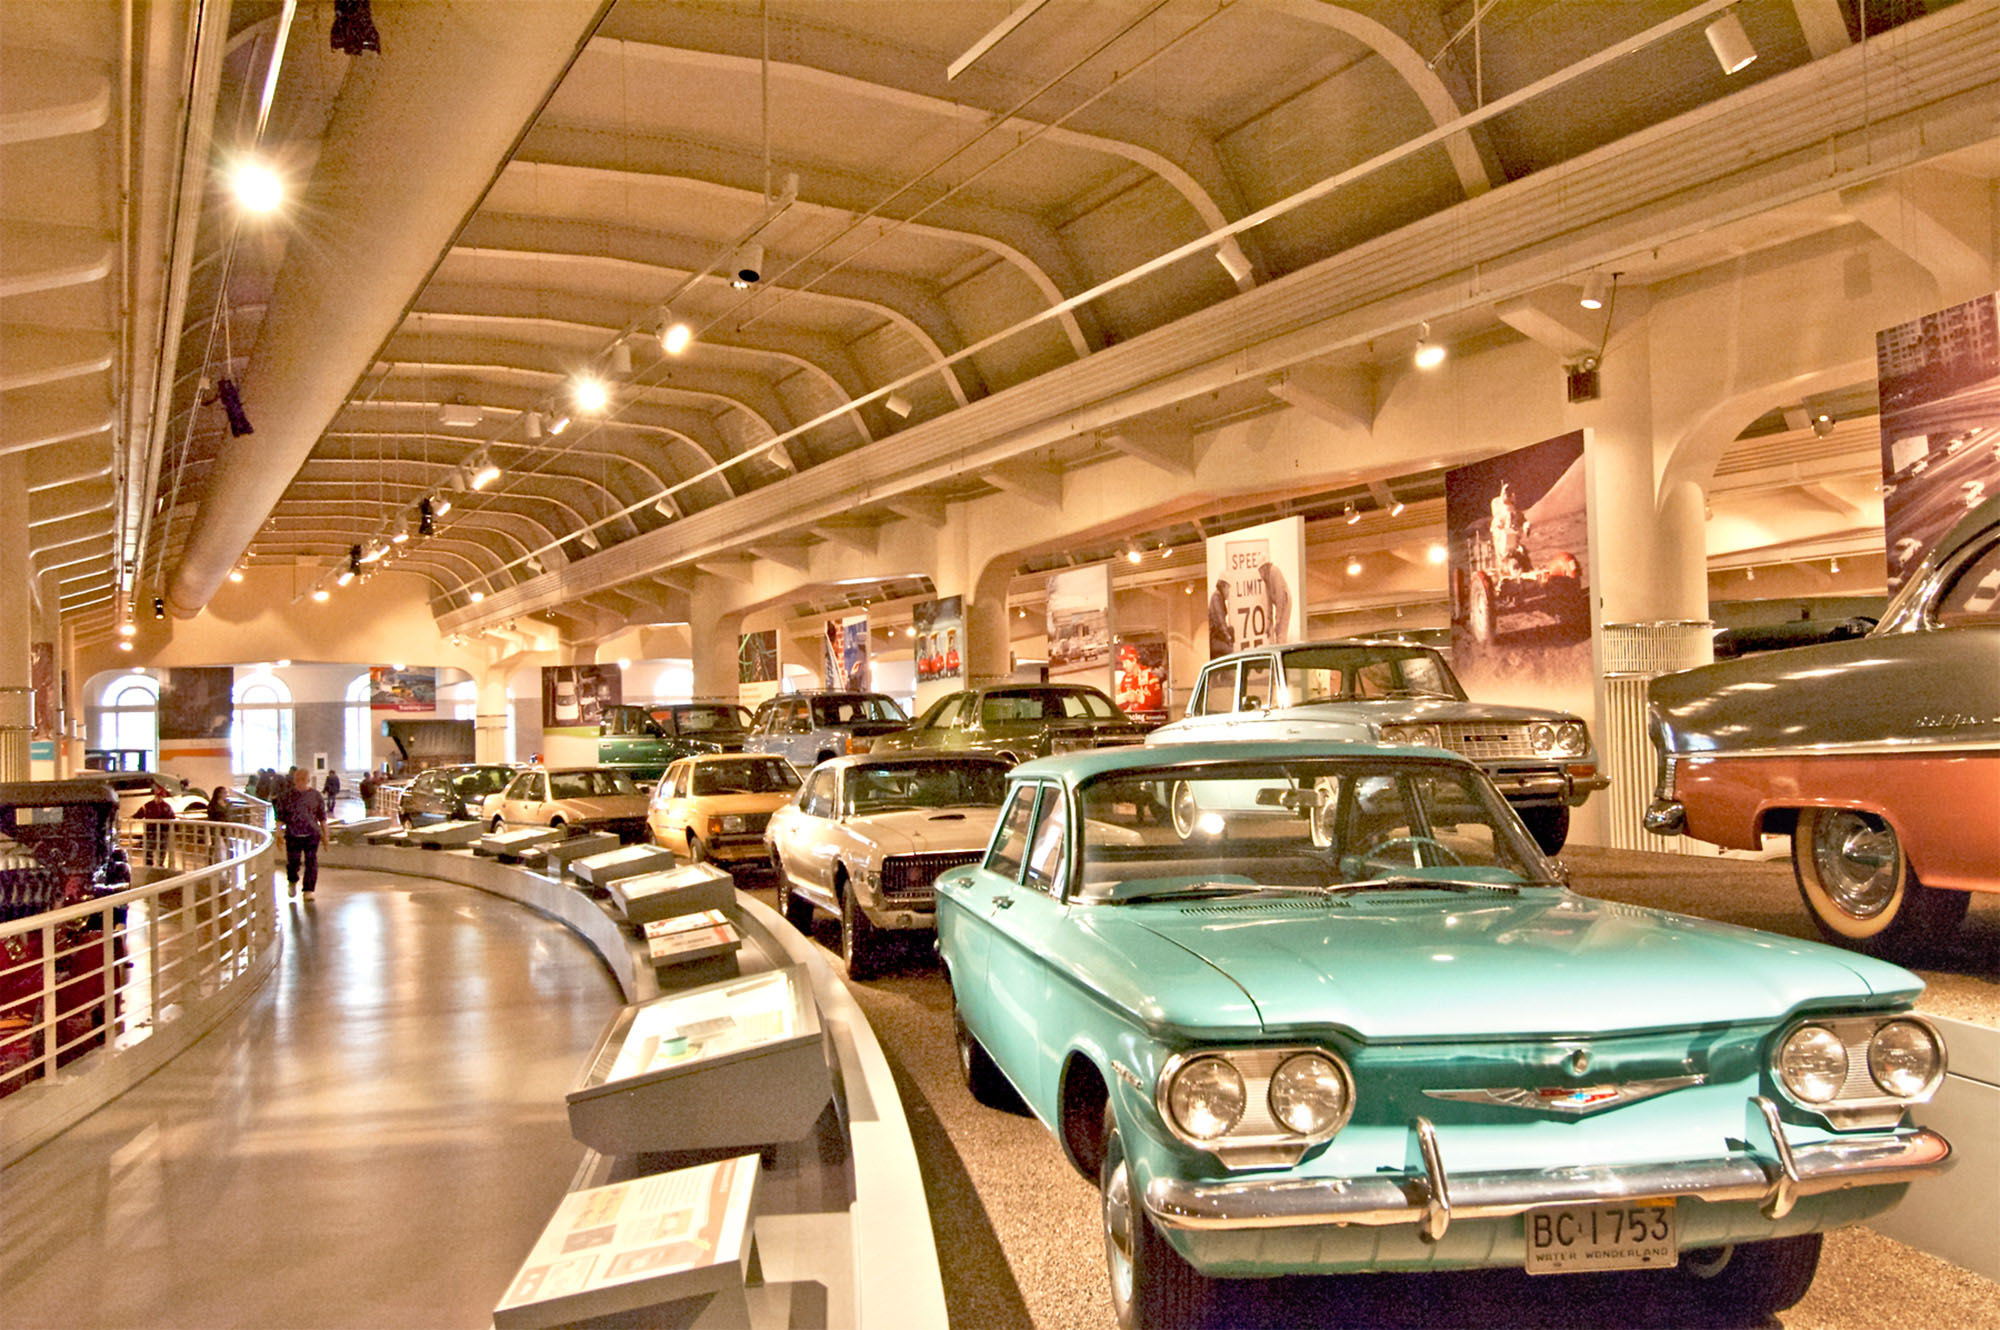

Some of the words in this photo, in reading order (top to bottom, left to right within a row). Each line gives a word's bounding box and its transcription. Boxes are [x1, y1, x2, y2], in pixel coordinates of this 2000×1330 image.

[1236, 578, 1263, 597] LIMIT
[1237, 605, 1266, 639] 70
[1585, 1247, 1669, 1260] WONDERLAND
